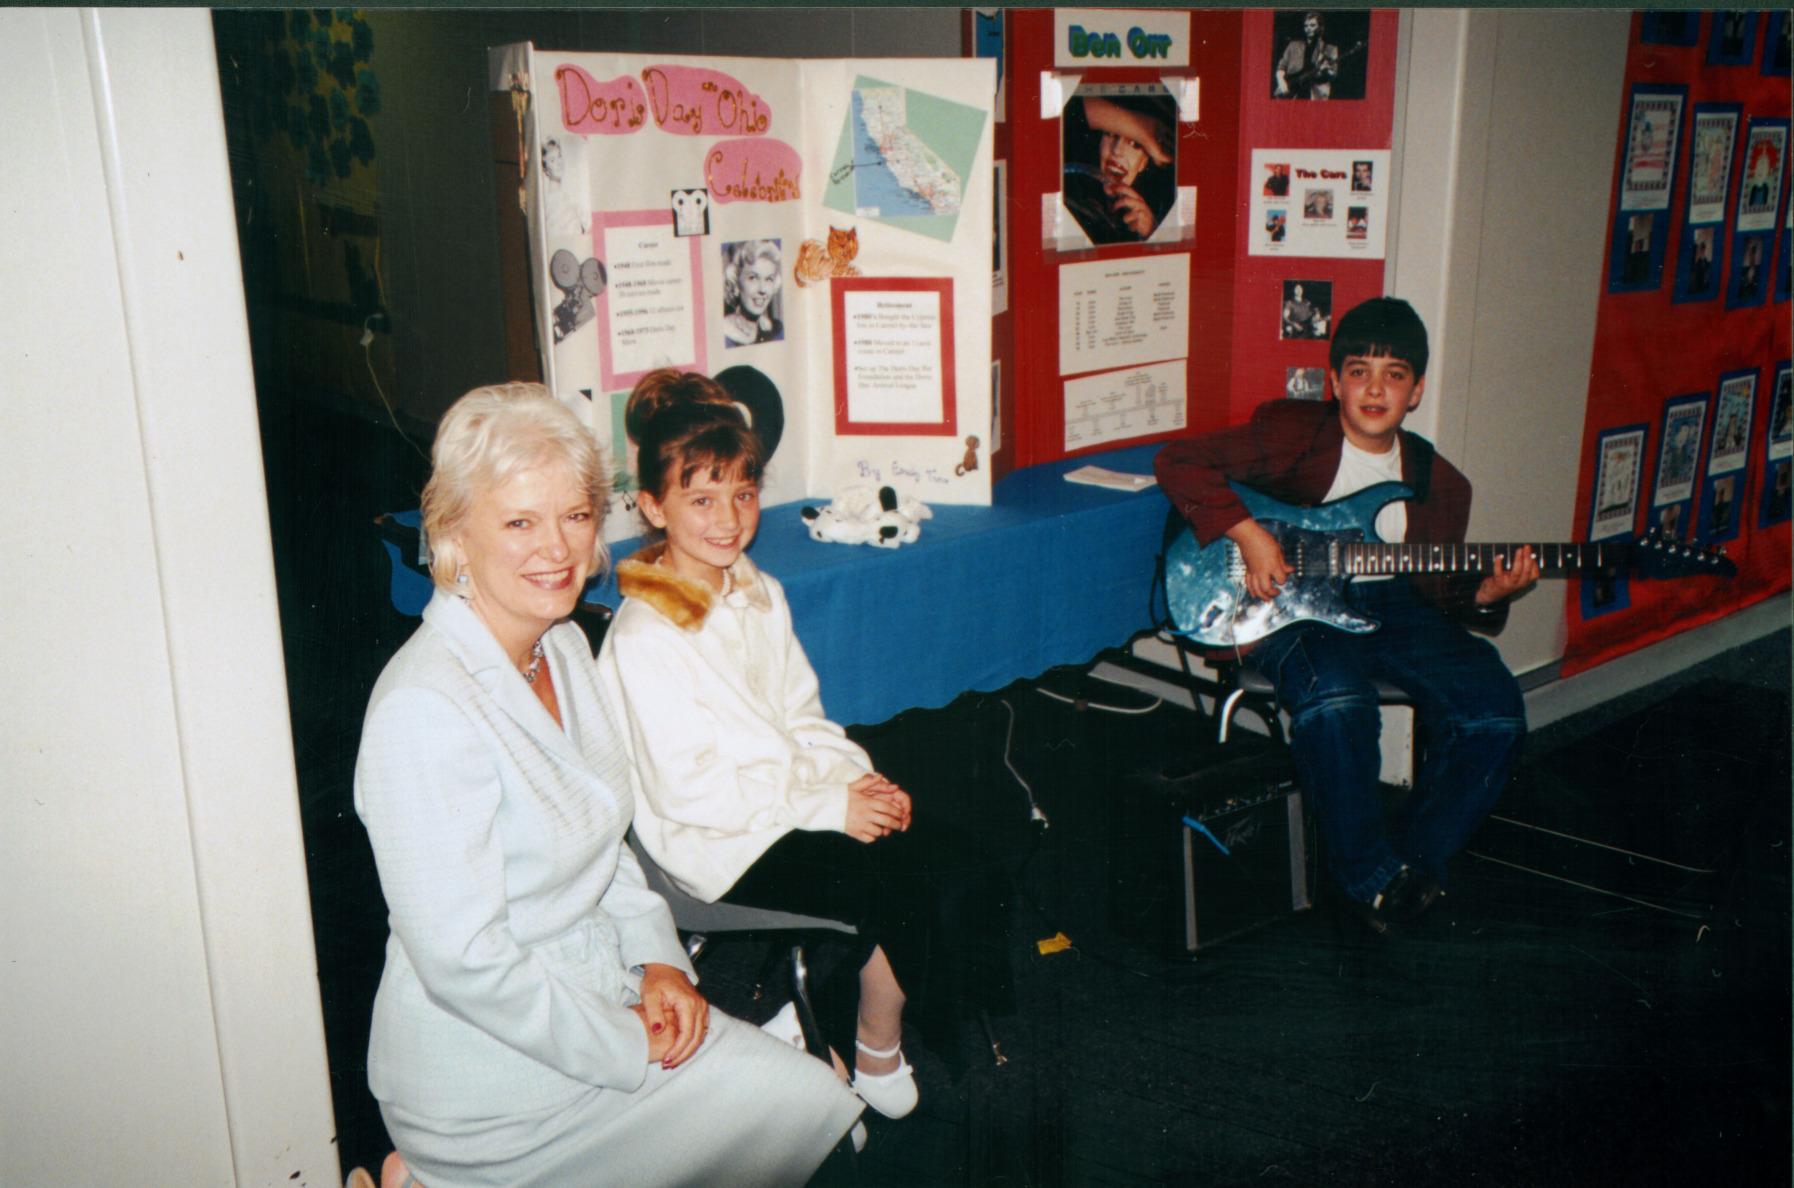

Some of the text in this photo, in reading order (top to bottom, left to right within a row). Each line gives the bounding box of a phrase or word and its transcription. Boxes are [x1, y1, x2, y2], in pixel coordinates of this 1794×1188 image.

[1068, 24, 1173, 59] Ben Orr
[555, 67, 644, 128] Doris
[641, 68, 703, 134] Day
[717, 89, 768, 135] Ohio
[1295, 168, 1347, 179] The Cars
[857, 460, 882, 481] By
